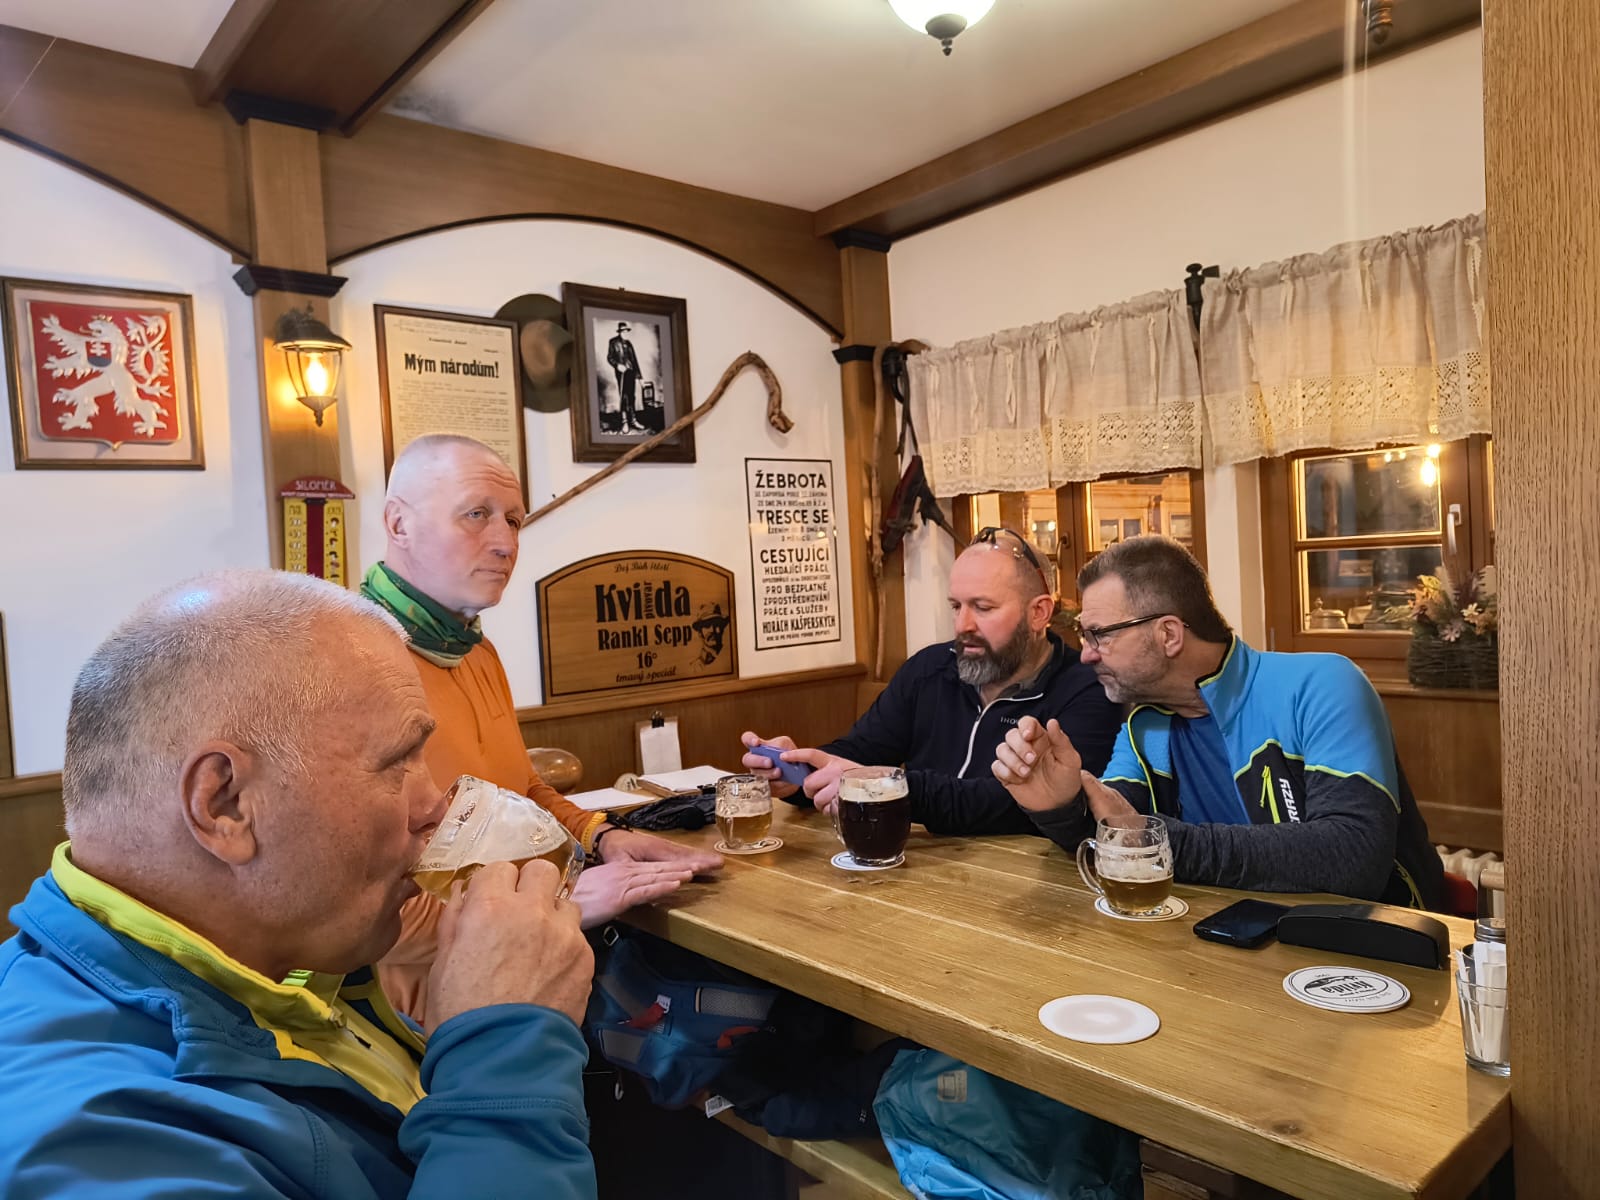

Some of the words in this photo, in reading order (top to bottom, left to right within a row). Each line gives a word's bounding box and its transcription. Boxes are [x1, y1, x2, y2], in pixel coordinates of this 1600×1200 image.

[404, 353, 436, 375] Mým
[755, 470, 827, 488] ŽEBROTA
[757, 509, 809, 525] TRESCE
[812, 509, 829, 524] SE
[766, 585, 782, 595] PRO
[598, 625, 649, 651] Rankl
[654, 624, 693, 648] Sepp
